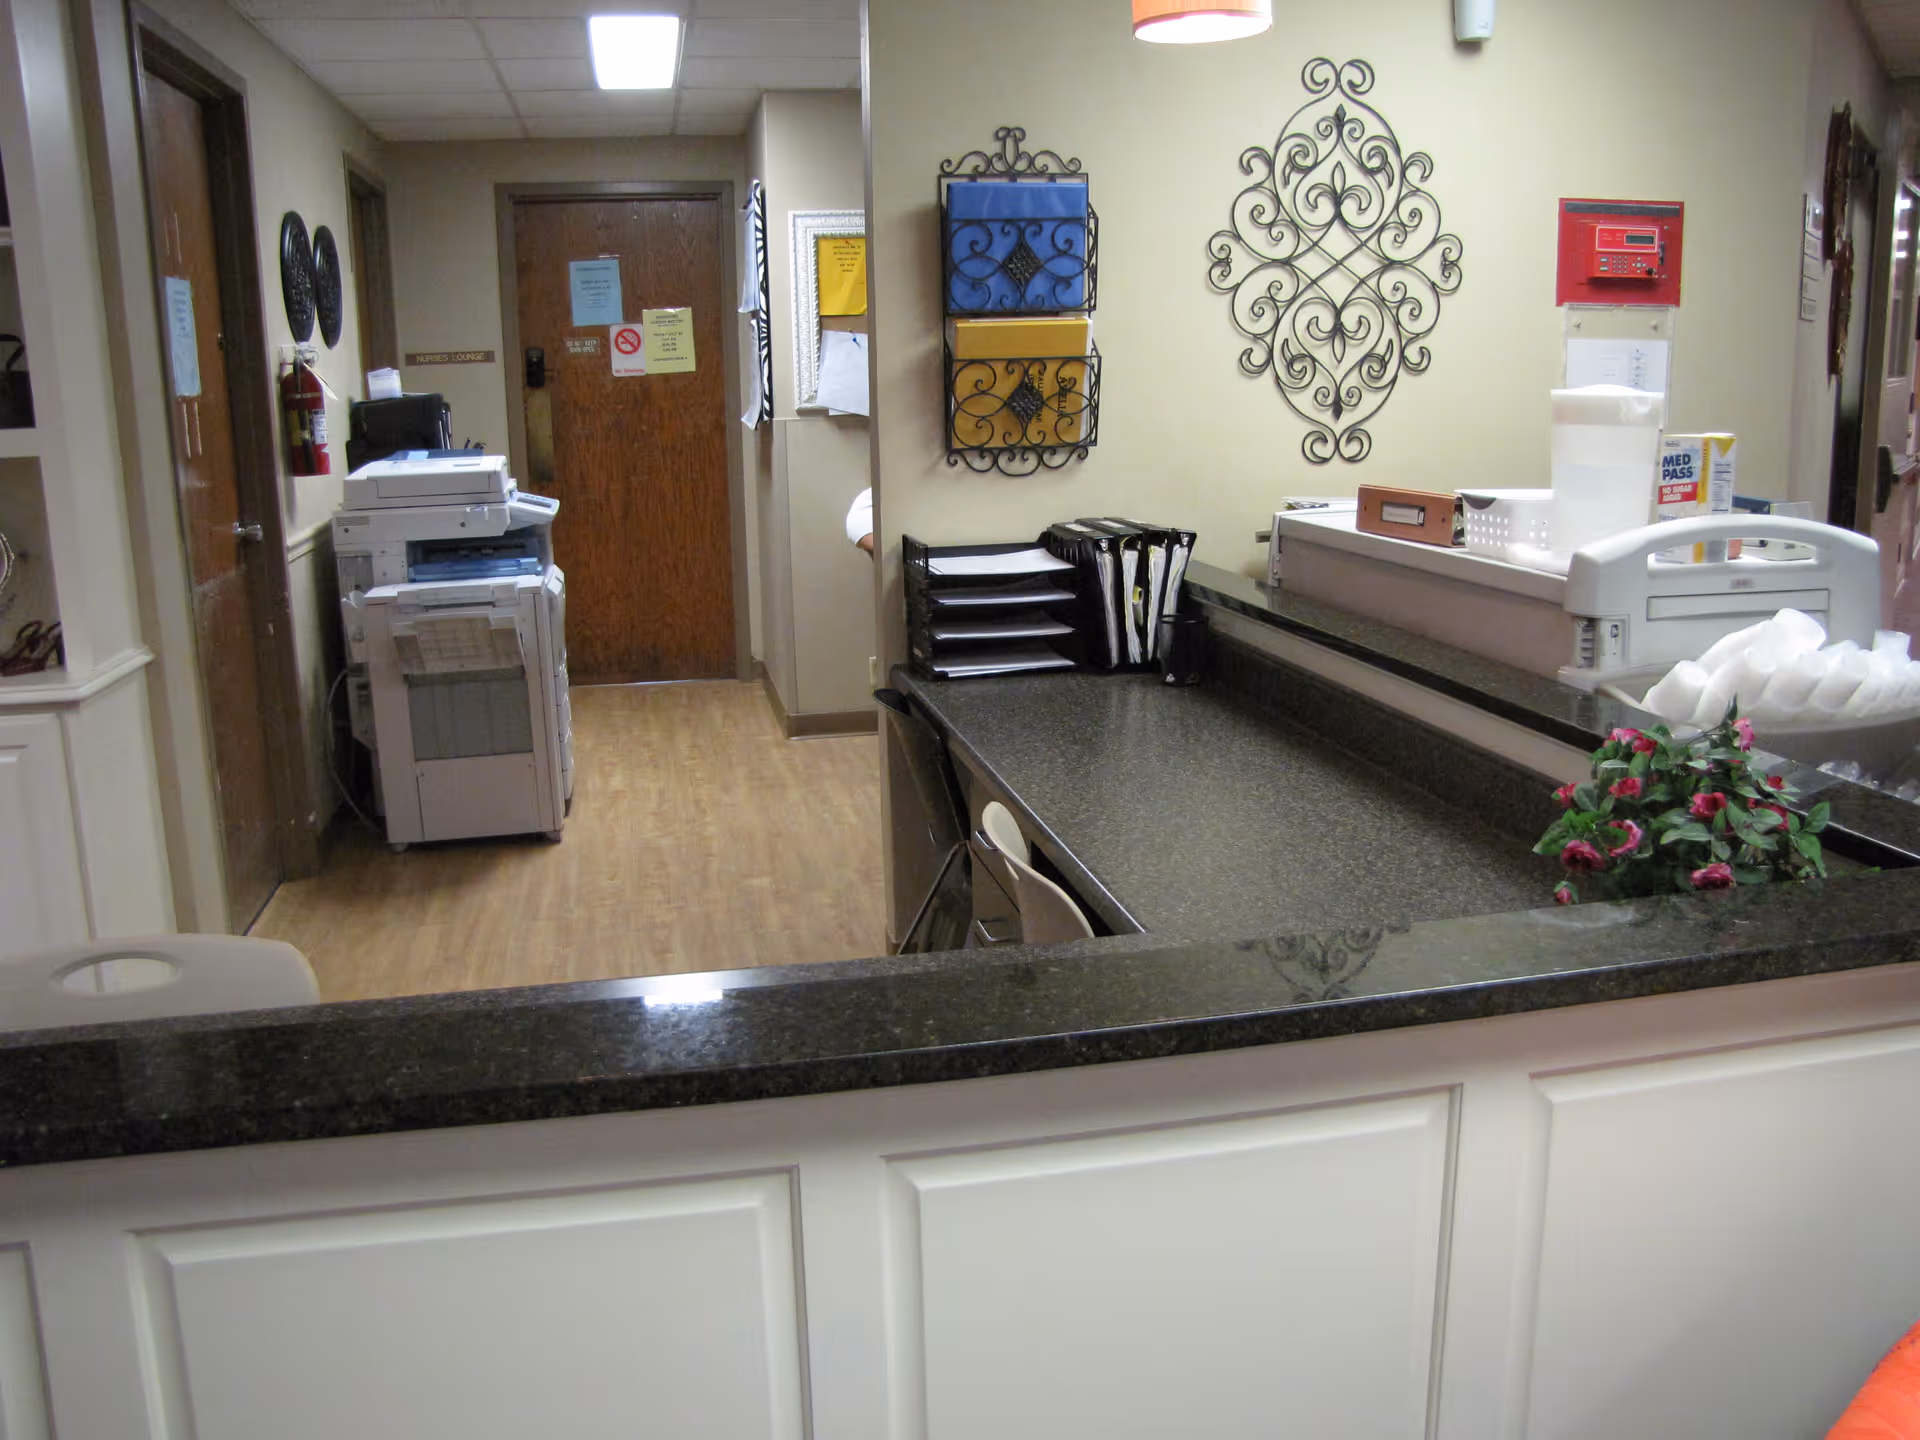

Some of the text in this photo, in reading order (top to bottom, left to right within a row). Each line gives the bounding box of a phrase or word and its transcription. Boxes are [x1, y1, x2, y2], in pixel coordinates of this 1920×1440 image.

[416, 352, 485, 363] NURSES LOUNGE
[1662, 453, 1691, 468] MED
[1662, 466, 1694, 481] PASS
[1662, 485, 1692, 495] NO SUGAR
